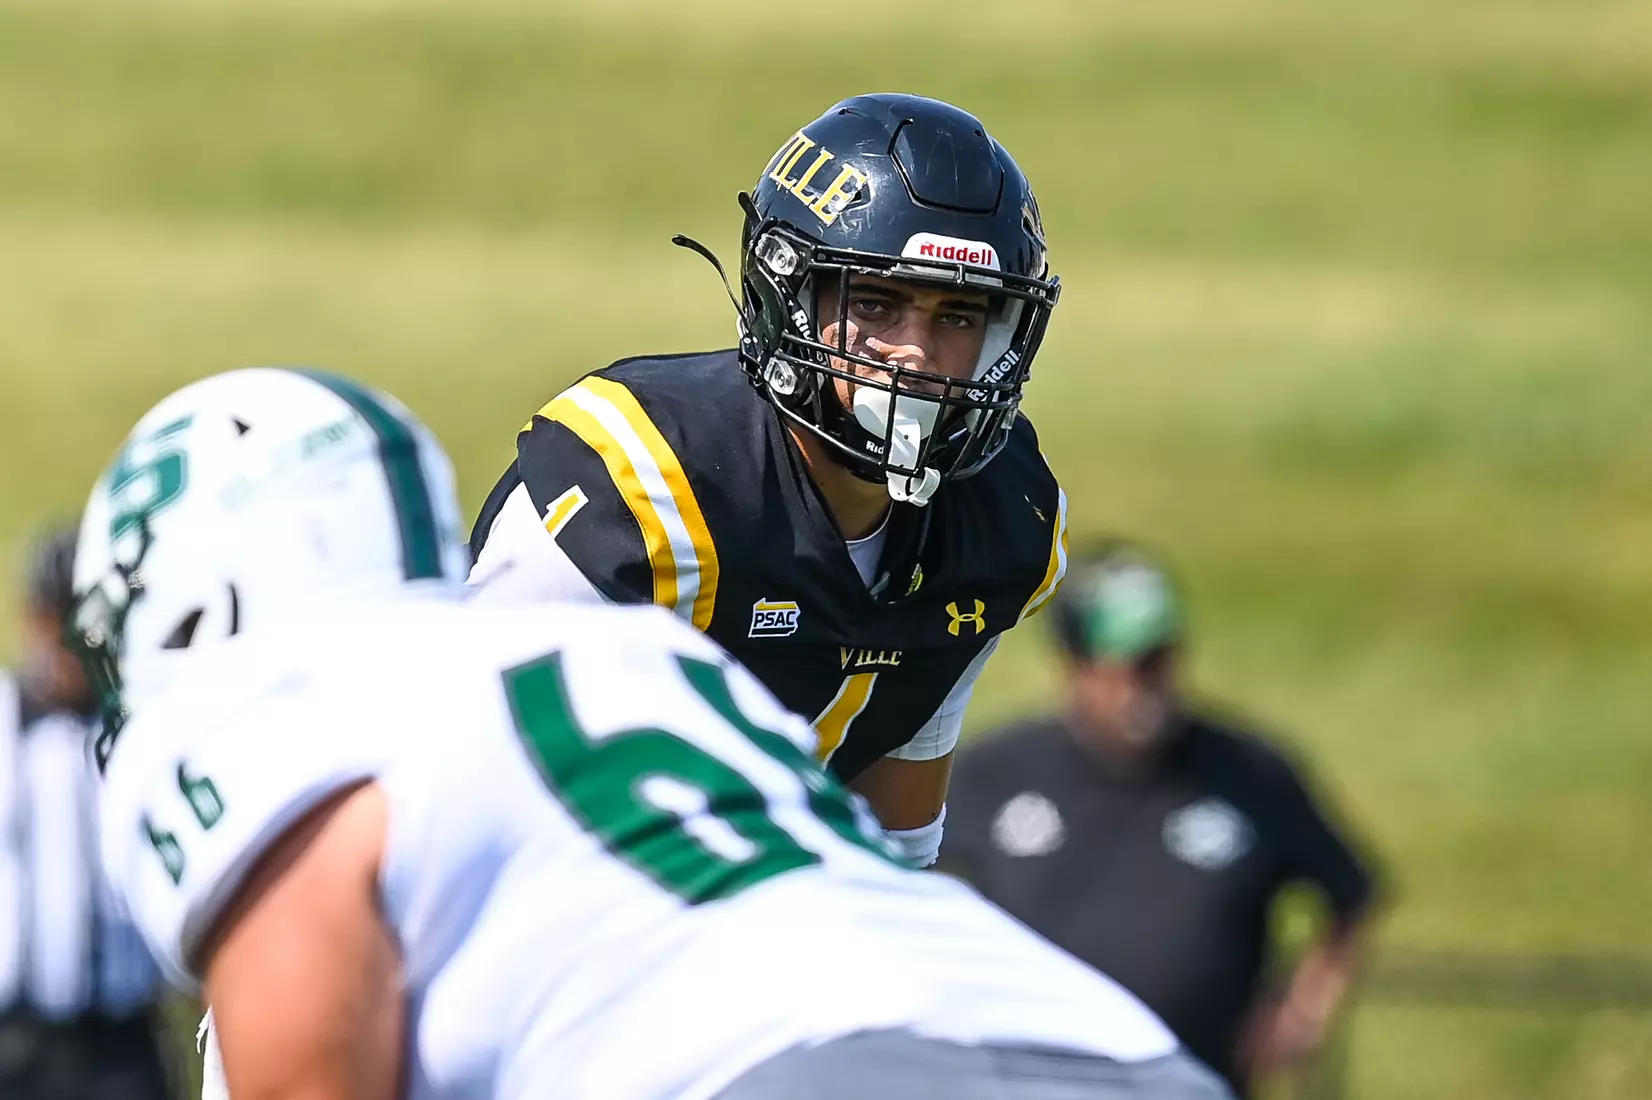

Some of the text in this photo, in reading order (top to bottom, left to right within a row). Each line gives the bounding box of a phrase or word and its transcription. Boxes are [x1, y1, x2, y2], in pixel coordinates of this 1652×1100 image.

[920, 242, 992, 265] Riddell
[753, 611, 796, 628] PSAC
[840, 646, 903, 670] VILLE
